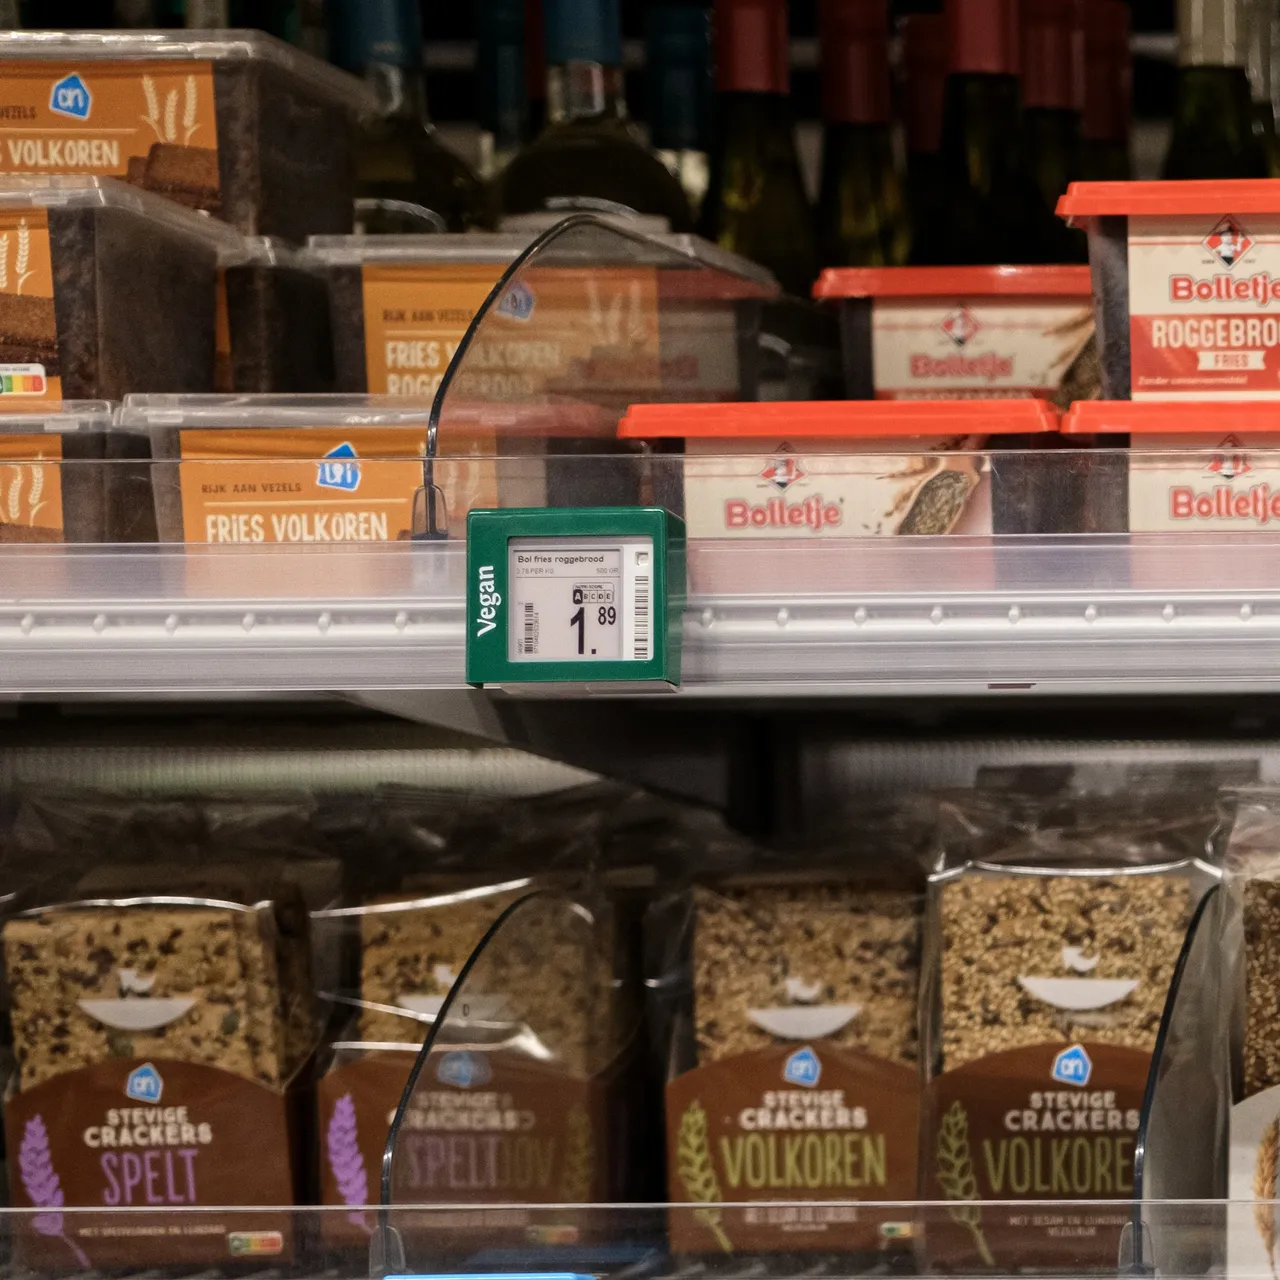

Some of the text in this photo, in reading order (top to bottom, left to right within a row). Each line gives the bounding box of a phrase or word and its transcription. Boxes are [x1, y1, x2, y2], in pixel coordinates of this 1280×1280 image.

[7, 140, 119, 167] VOLKOREN
[205, 512, 389, 543] FRIES VOLKOREN
[518, 555, 604, 565] Bol fries roggebrood
[477, 565, 502, 637] Vegan
[598, 606, 616, 625] 89
[764, 1092, 844, 1110] STEVIGE
[106, 1106, 188, 1126] STEVIGE
[740, 1106, 868, 1131] CRACKERS
[84, 1123, 213, 1147] CRACKERS
[721, 1134, 886, 1189] VOLKOREN
[101, 1149, 199, 1205] SPELT
